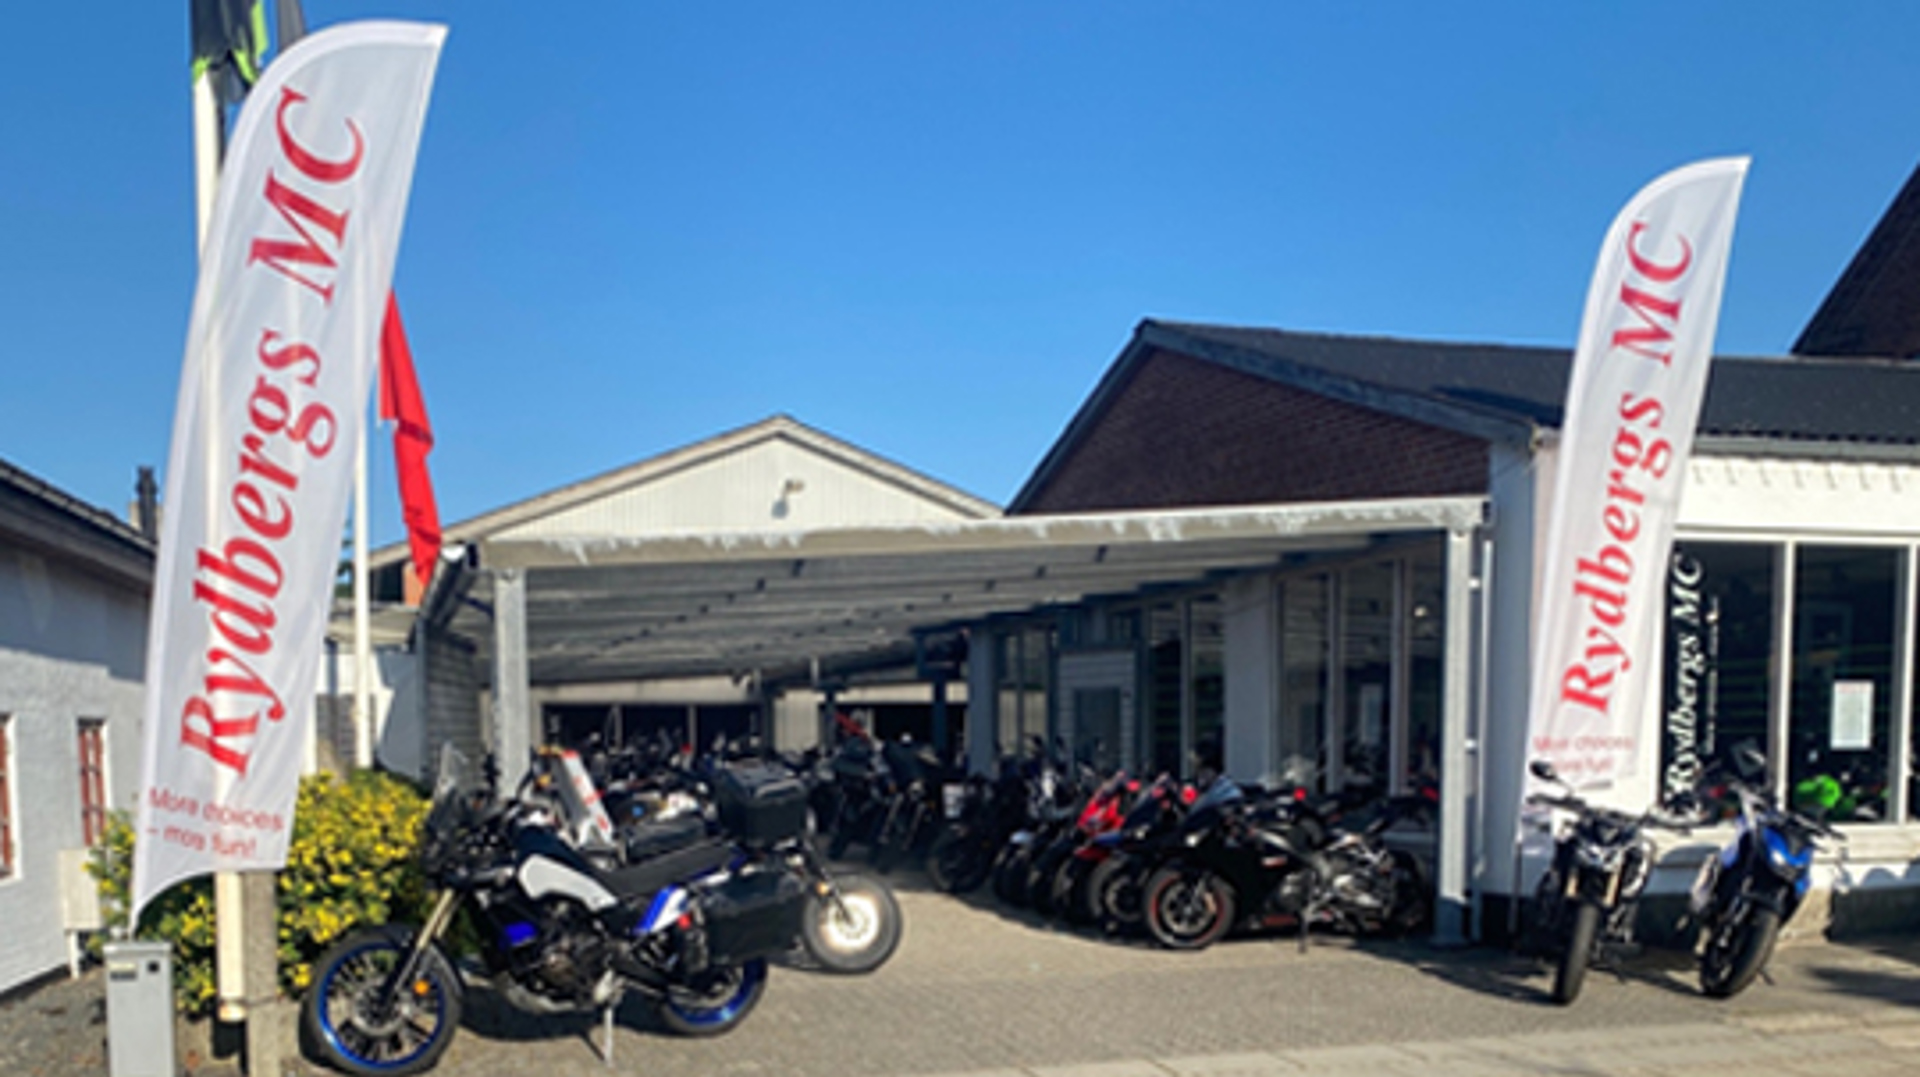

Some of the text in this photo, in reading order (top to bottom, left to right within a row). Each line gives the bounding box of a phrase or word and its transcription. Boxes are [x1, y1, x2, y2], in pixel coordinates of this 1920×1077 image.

[179, 85, 366, 779] Rydbergs MC
[1558, 220, 1692, 715] Rydbergs MC
[148, 786, 200, 818] More
[1664, 553, 1704, 801] Rydbergs MC
